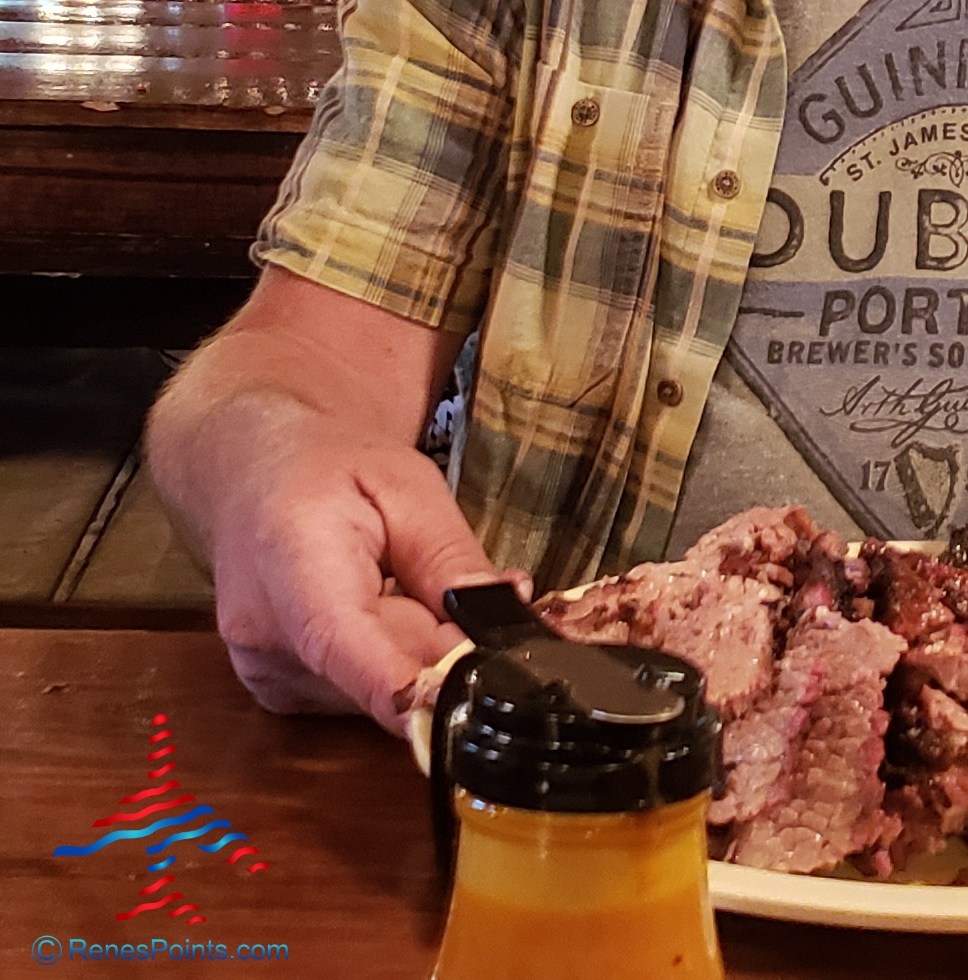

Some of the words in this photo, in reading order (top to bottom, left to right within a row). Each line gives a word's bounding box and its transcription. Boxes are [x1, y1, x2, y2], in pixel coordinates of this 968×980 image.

[846, 152, 882, 182] ST.
[766, 339, 918, 366] BREWER'S
[860, 460, 892, 492] 17
